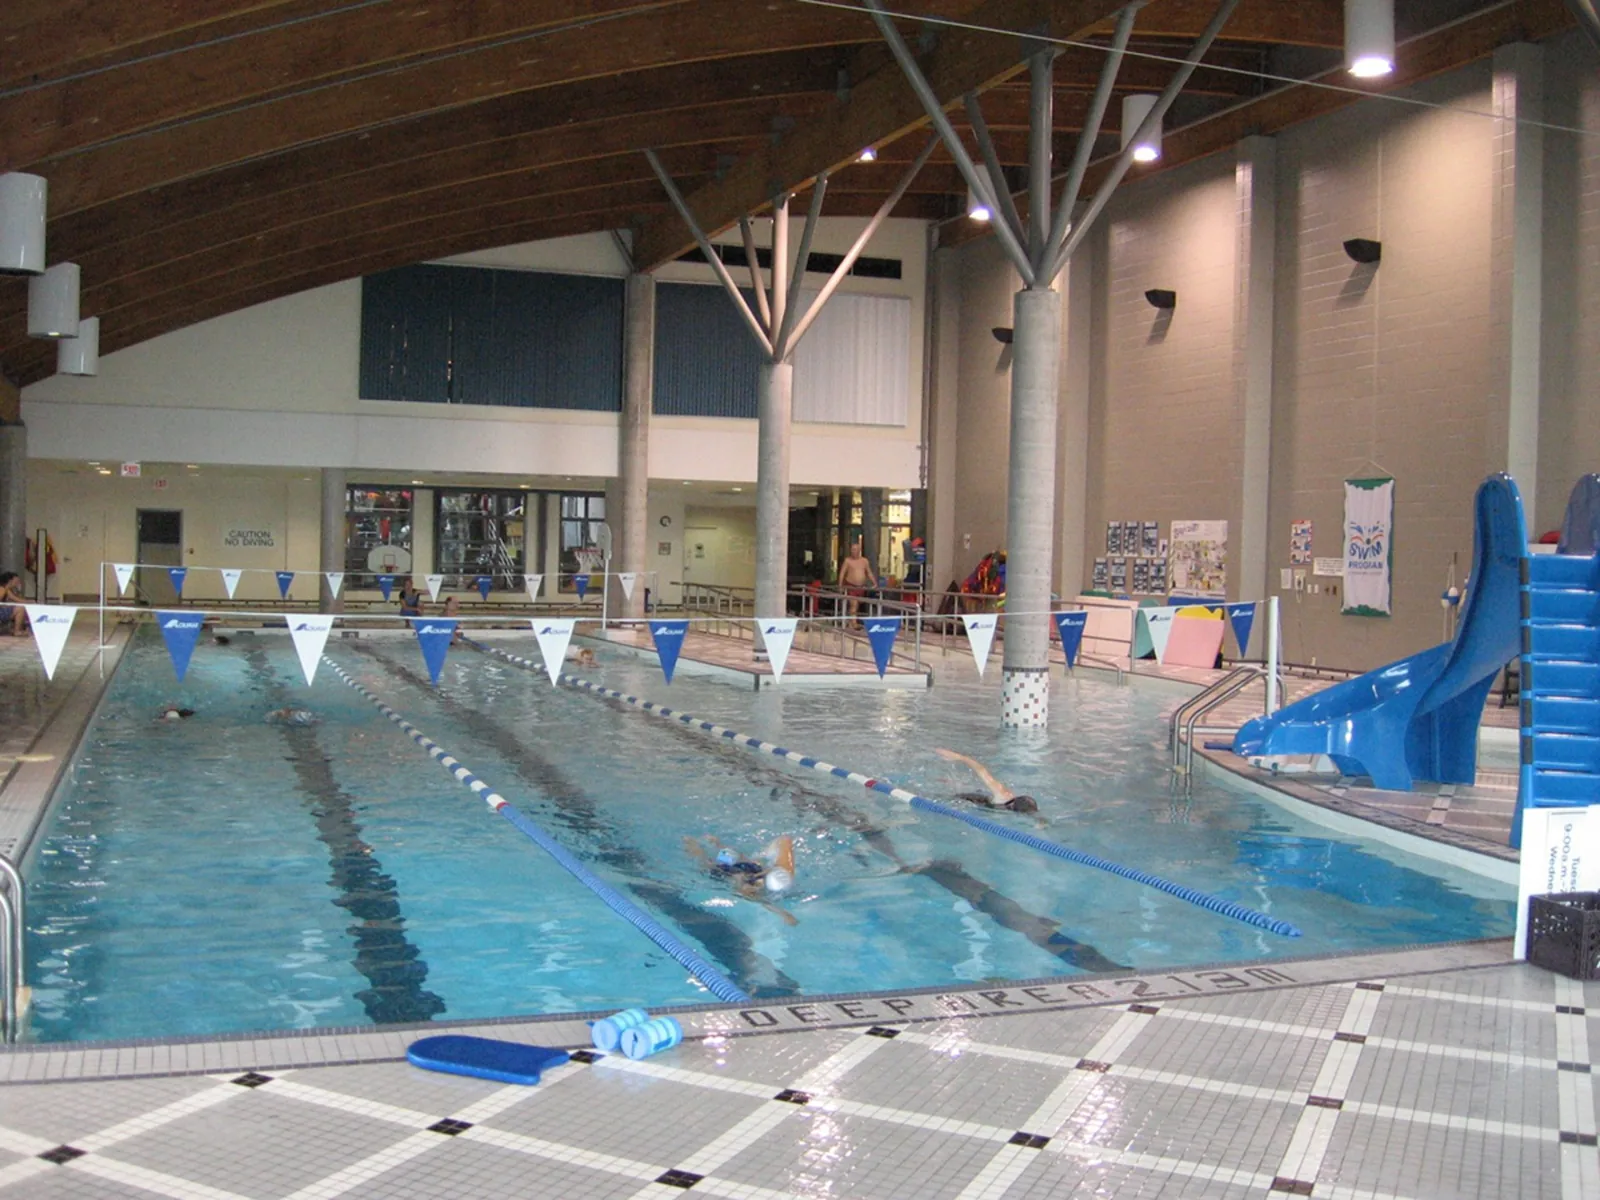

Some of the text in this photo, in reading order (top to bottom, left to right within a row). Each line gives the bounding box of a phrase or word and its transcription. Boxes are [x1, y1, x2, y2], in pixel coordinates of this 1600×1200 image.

[225, 538, 274, 547] NO DIVING
[229, 530, 271, 538] CAUTION
[1349, 540, 1383, 560] SWIM
[1547, 846, 1558, 893] Wedne
[740, 999, 914, 1028] DEEP
[935, 984, 1112, 1012] AREA
